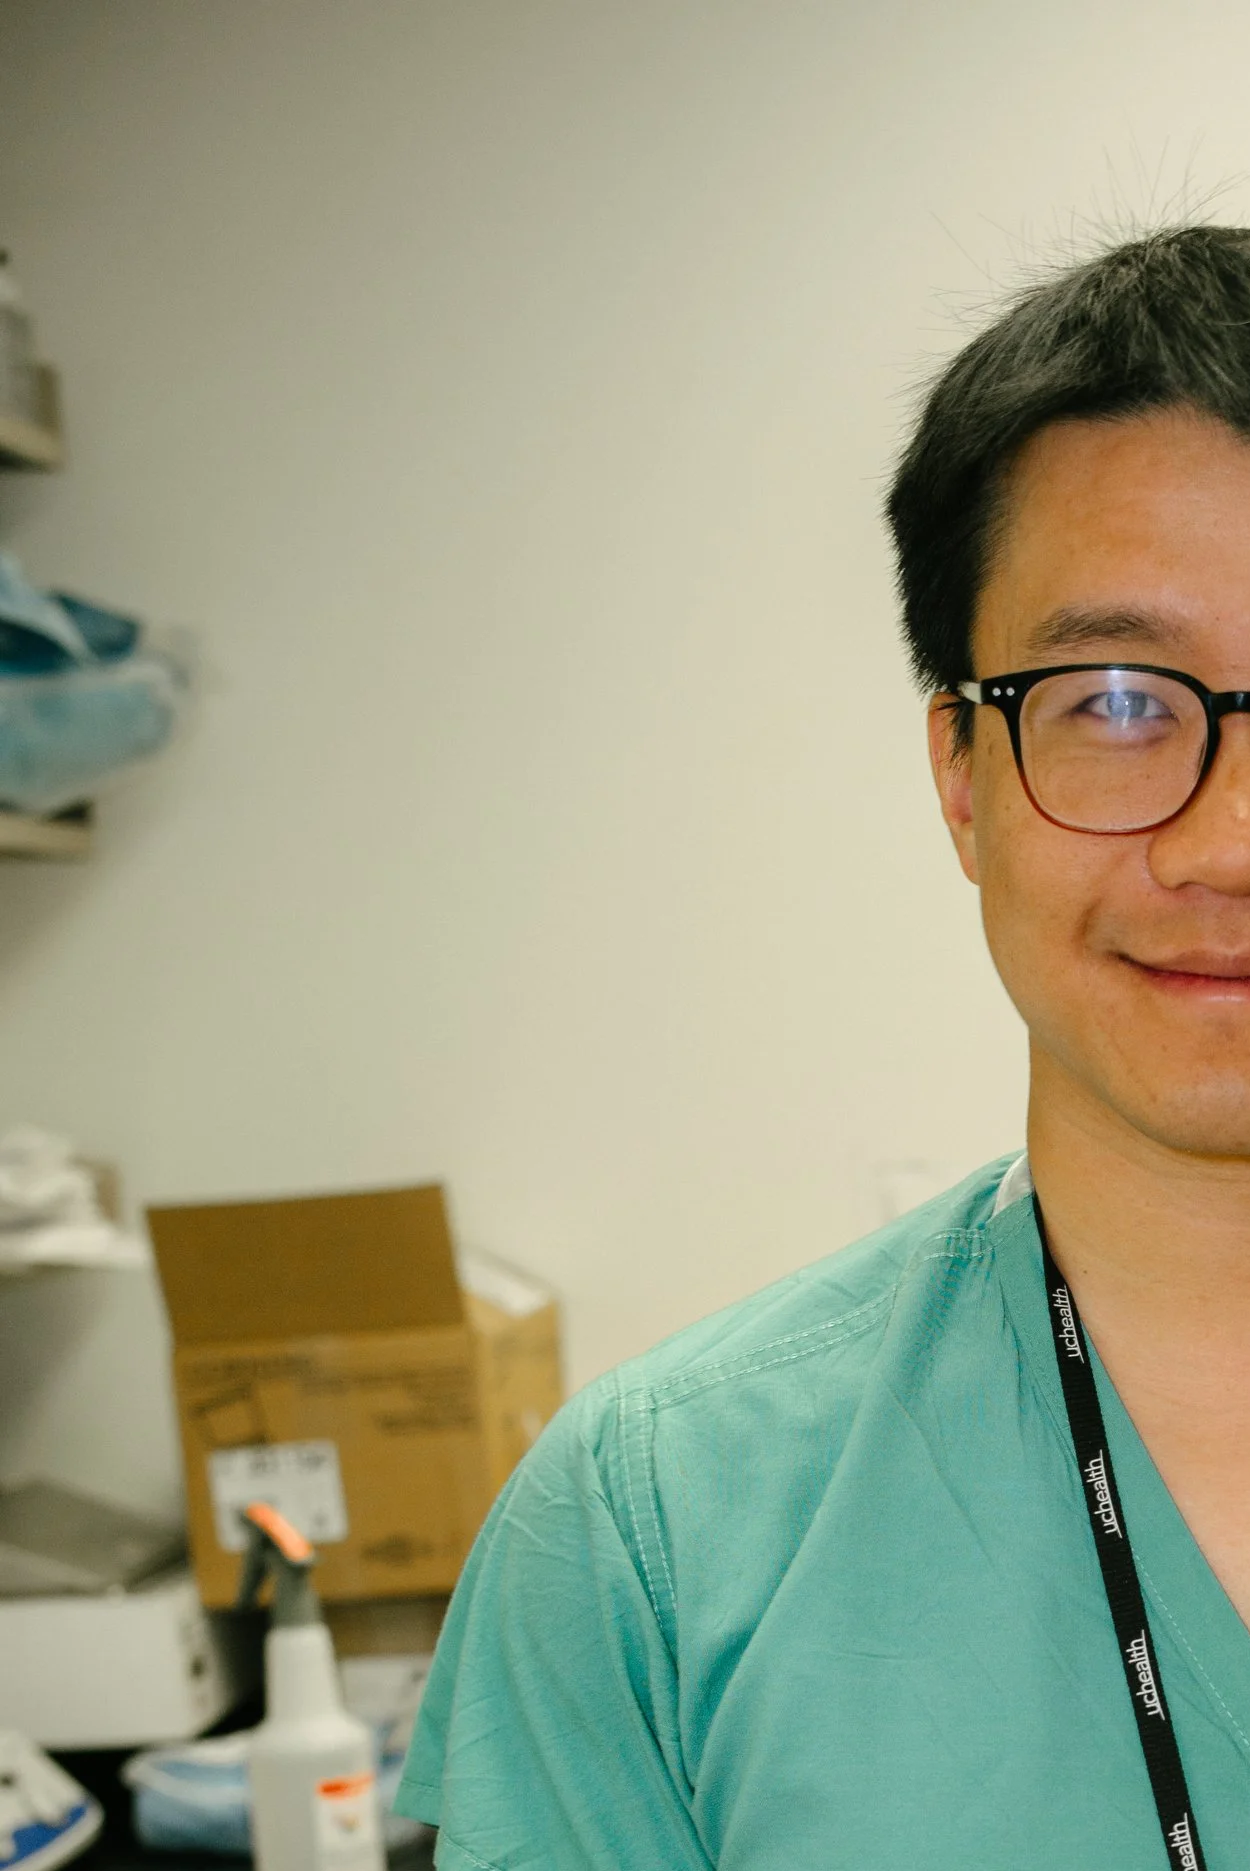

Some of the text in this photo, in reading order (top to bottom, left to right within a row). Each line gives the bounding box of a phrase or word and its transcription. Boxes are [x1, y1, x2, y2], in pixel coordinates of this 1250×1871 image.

[1053, 1286, 1084, 1363] uchealth
[1085, 1450, 1122, 1538] uchealth
[1126, 1630, 1165, 1720] uchealth
